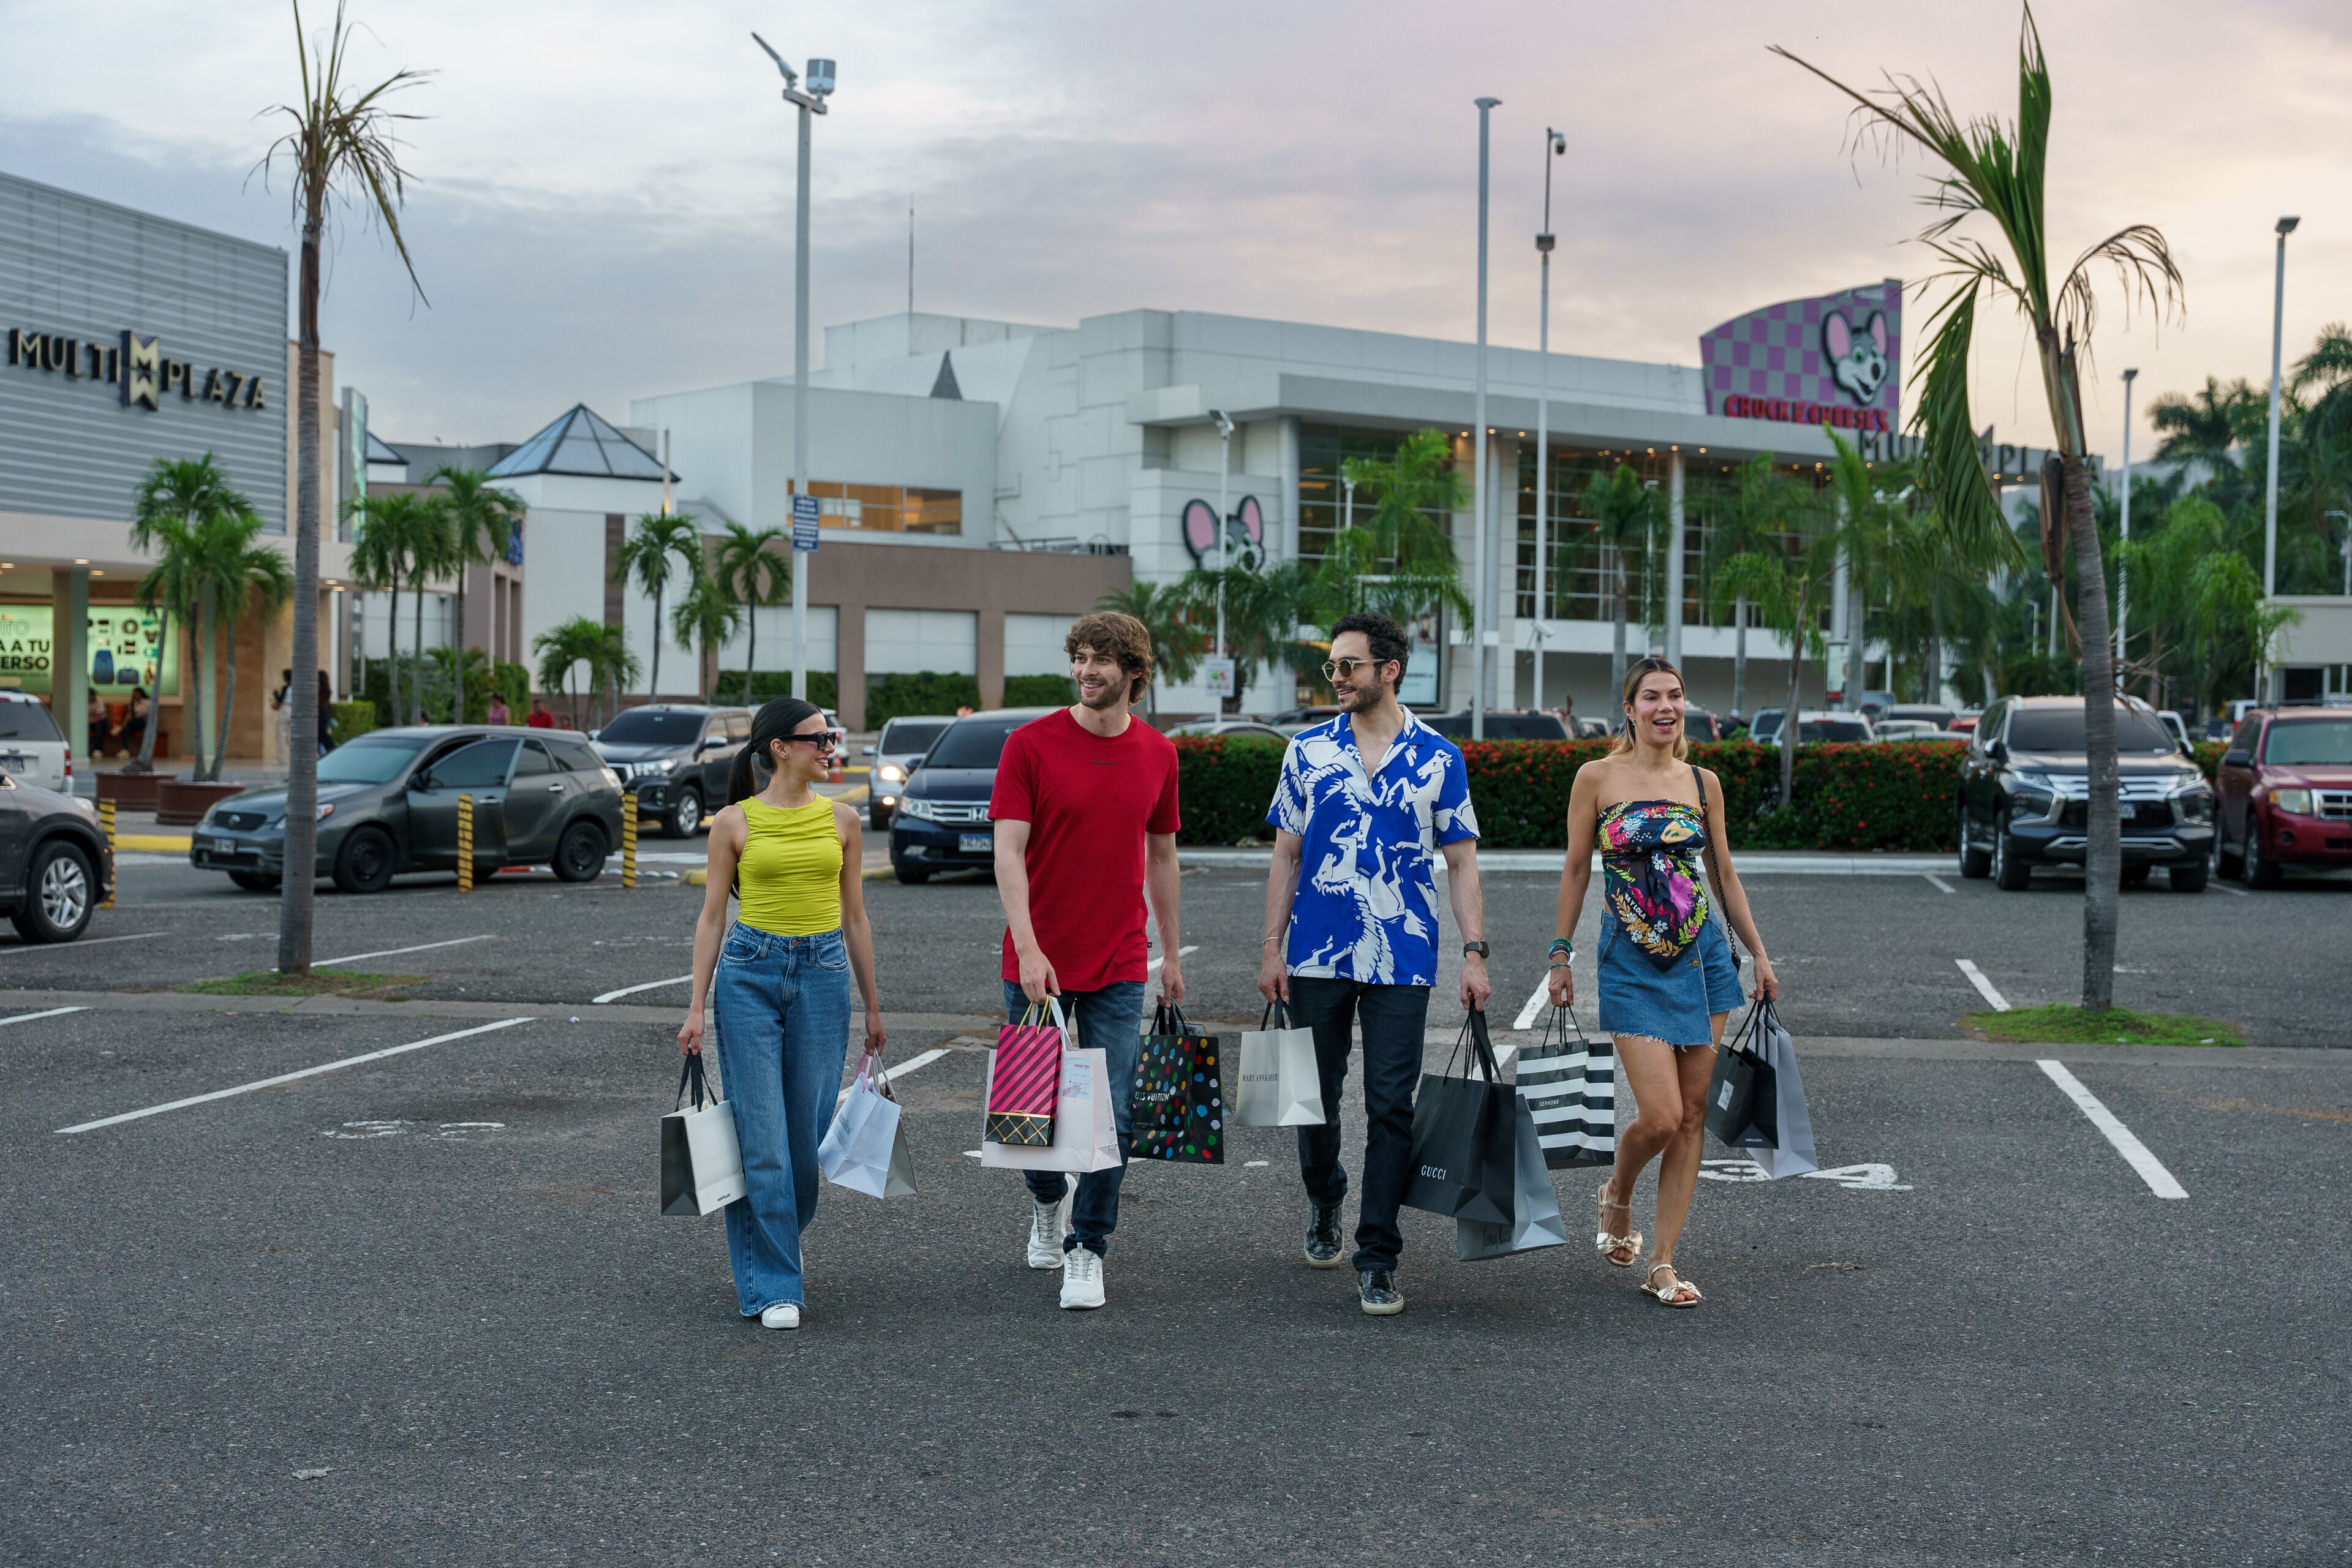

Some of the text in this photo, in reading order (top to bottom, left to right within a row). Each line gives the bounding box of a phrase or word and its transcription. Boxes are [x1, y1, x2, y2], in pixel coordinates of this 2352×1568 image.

[9, 328, 121, 383] MULTI
[161, 359, 266, 409] PLAZA
[1724, 393, 1890, 433] CHUCK E CHEESE'S
[11, 640, 23, 652] A
[28, 640, 50, 652] TU
[1, 656, 50, 670] ERSO
[1633, 904, 1646, 919] LOLA
[1134, 1091, 1170, 1102] UIS VUITTON
[1421, 1164, 1447, 1180] GUCCI
